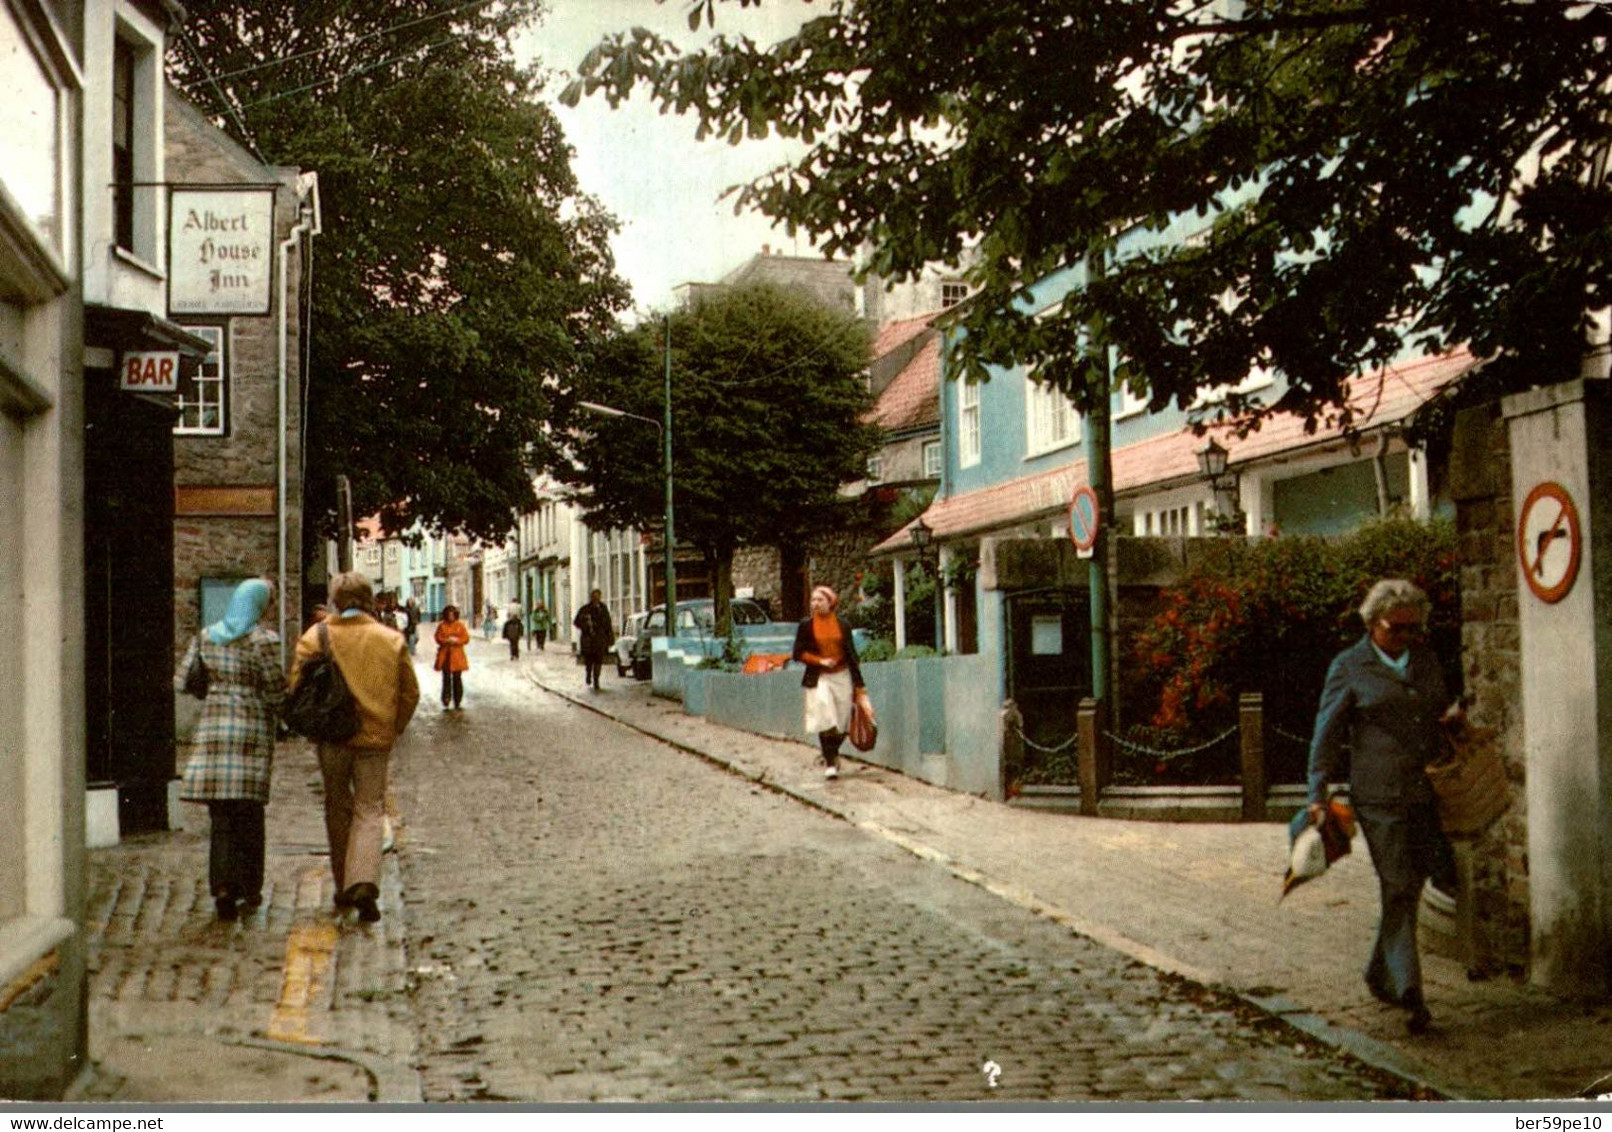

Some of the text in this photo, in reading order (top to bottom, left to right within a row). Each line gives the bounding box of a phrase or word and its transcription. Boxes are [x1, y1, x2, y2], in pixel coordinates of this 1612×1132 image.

[184, 209, 248, 232] Albert
[200, 238, 260, 263] House
[209, 270, 249, 292] Inn
[127, 357, 173, 385] BAR
